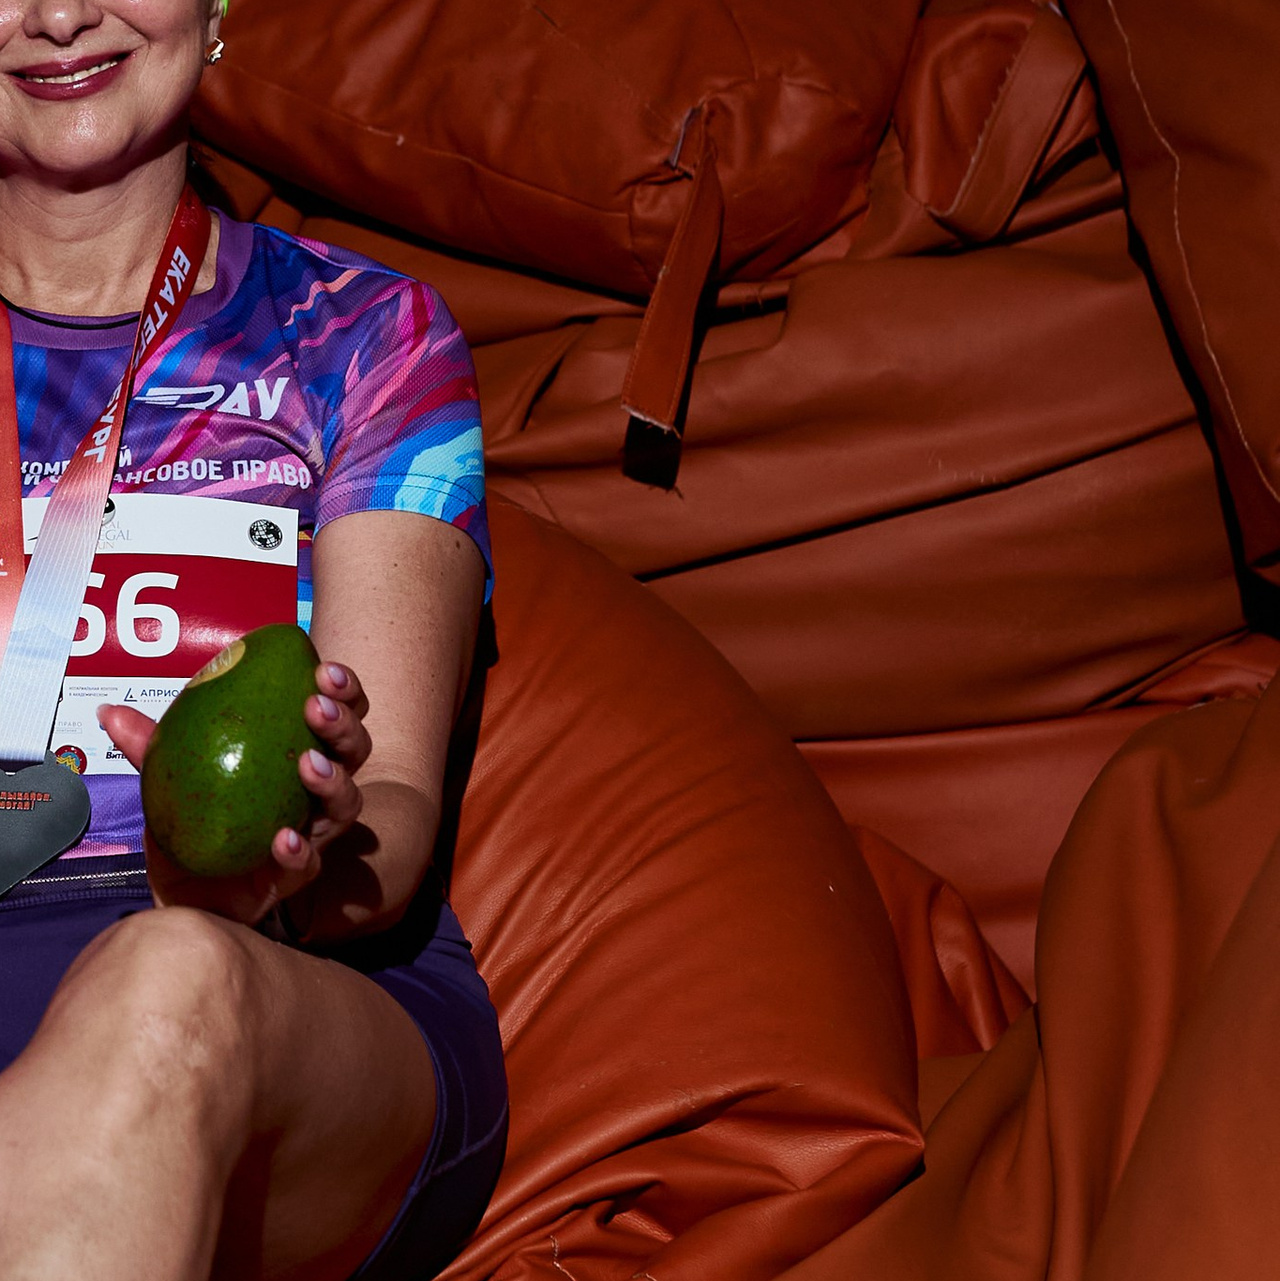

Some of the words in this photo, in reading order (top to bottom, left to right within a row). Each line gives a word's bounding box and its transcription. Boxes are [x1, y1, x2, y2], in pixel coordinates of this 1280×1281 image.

[232, 459, 312, 490] ПРАВО
[99, 529, 133, 541] EGAL
[140, 689, 180, 698] АПРИО
